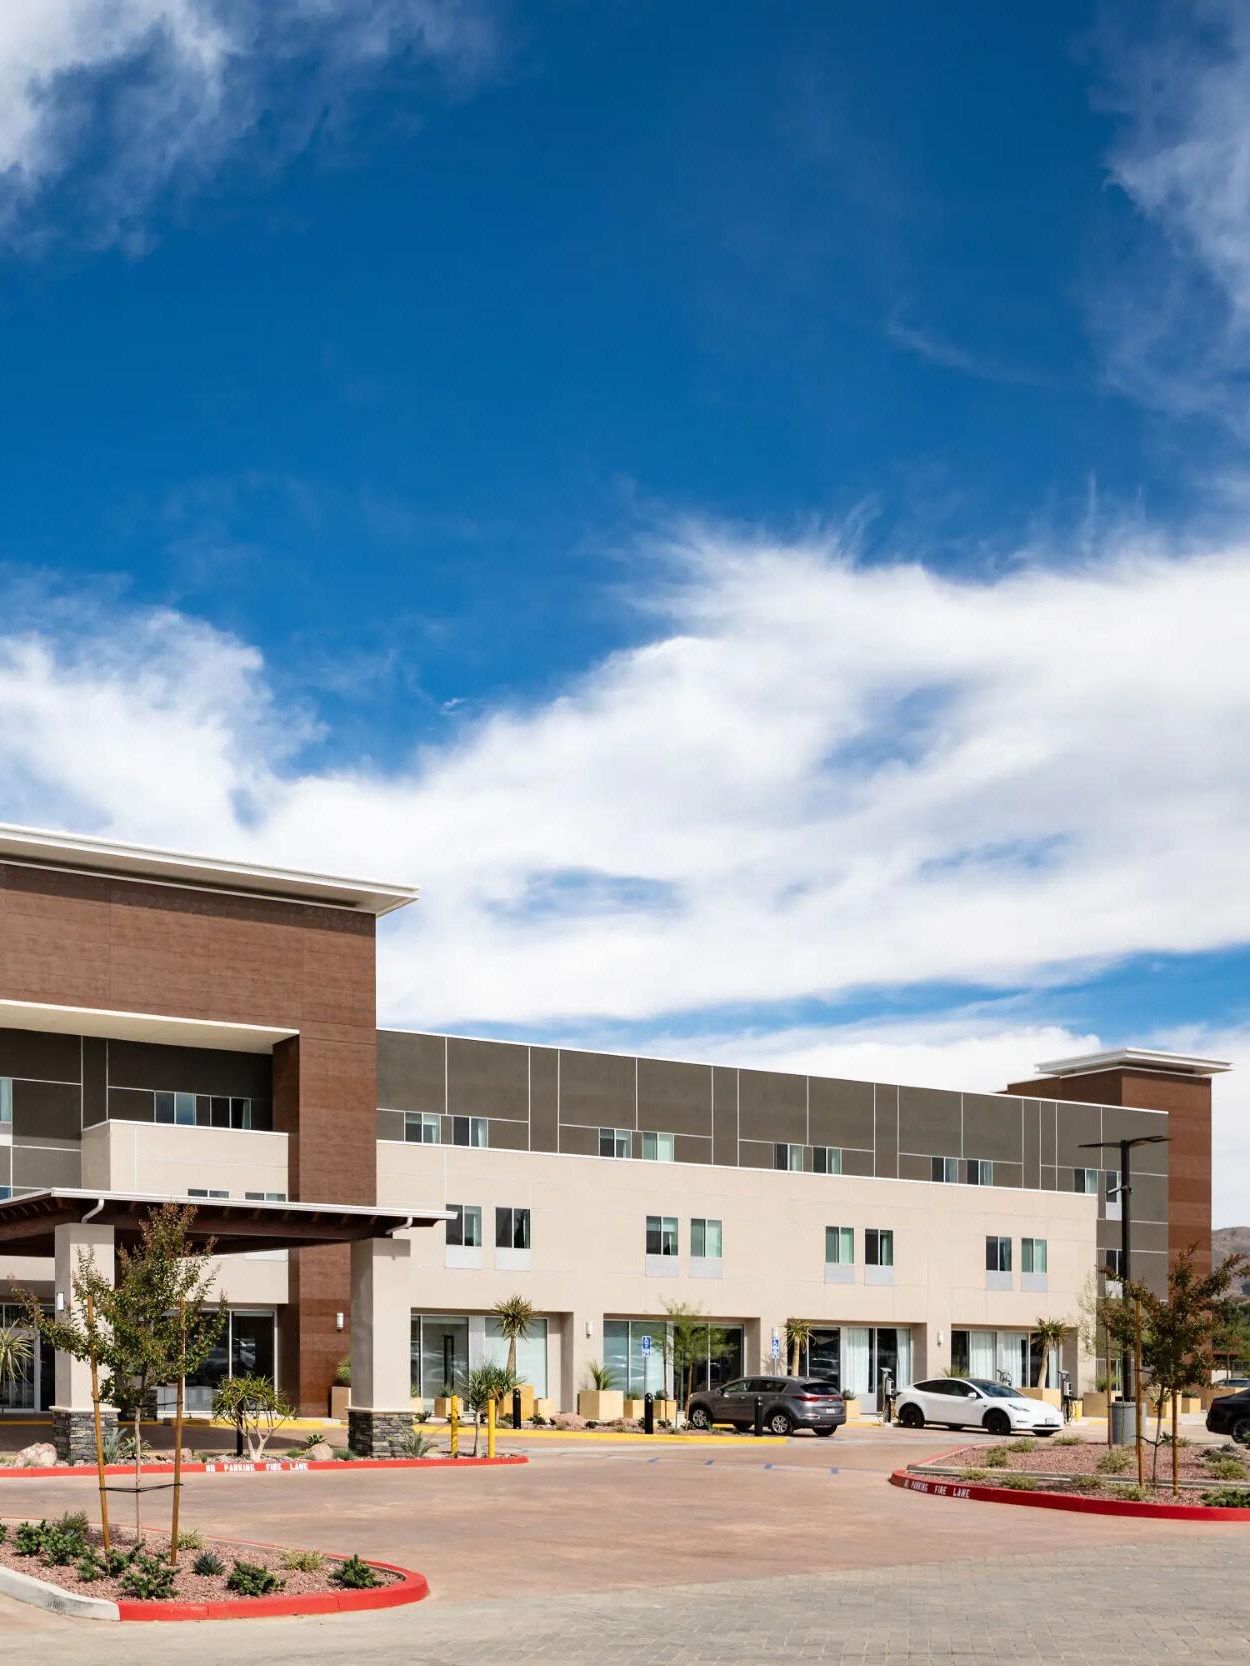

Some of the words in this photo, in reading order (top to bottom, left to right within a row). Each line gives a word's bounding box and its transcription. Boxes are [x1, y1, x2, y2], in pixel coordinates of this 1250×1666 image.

[205, 1464, 216, 1472] NO
[224, 1463, 255, 1472] PARKING
[266, 1463, 282, 1472] FIRE
[290, 1462, 309, 1471] LANE
[934, 1485, 947, 1495] FIRE
[953, 1487, 970, 1498] LANE
